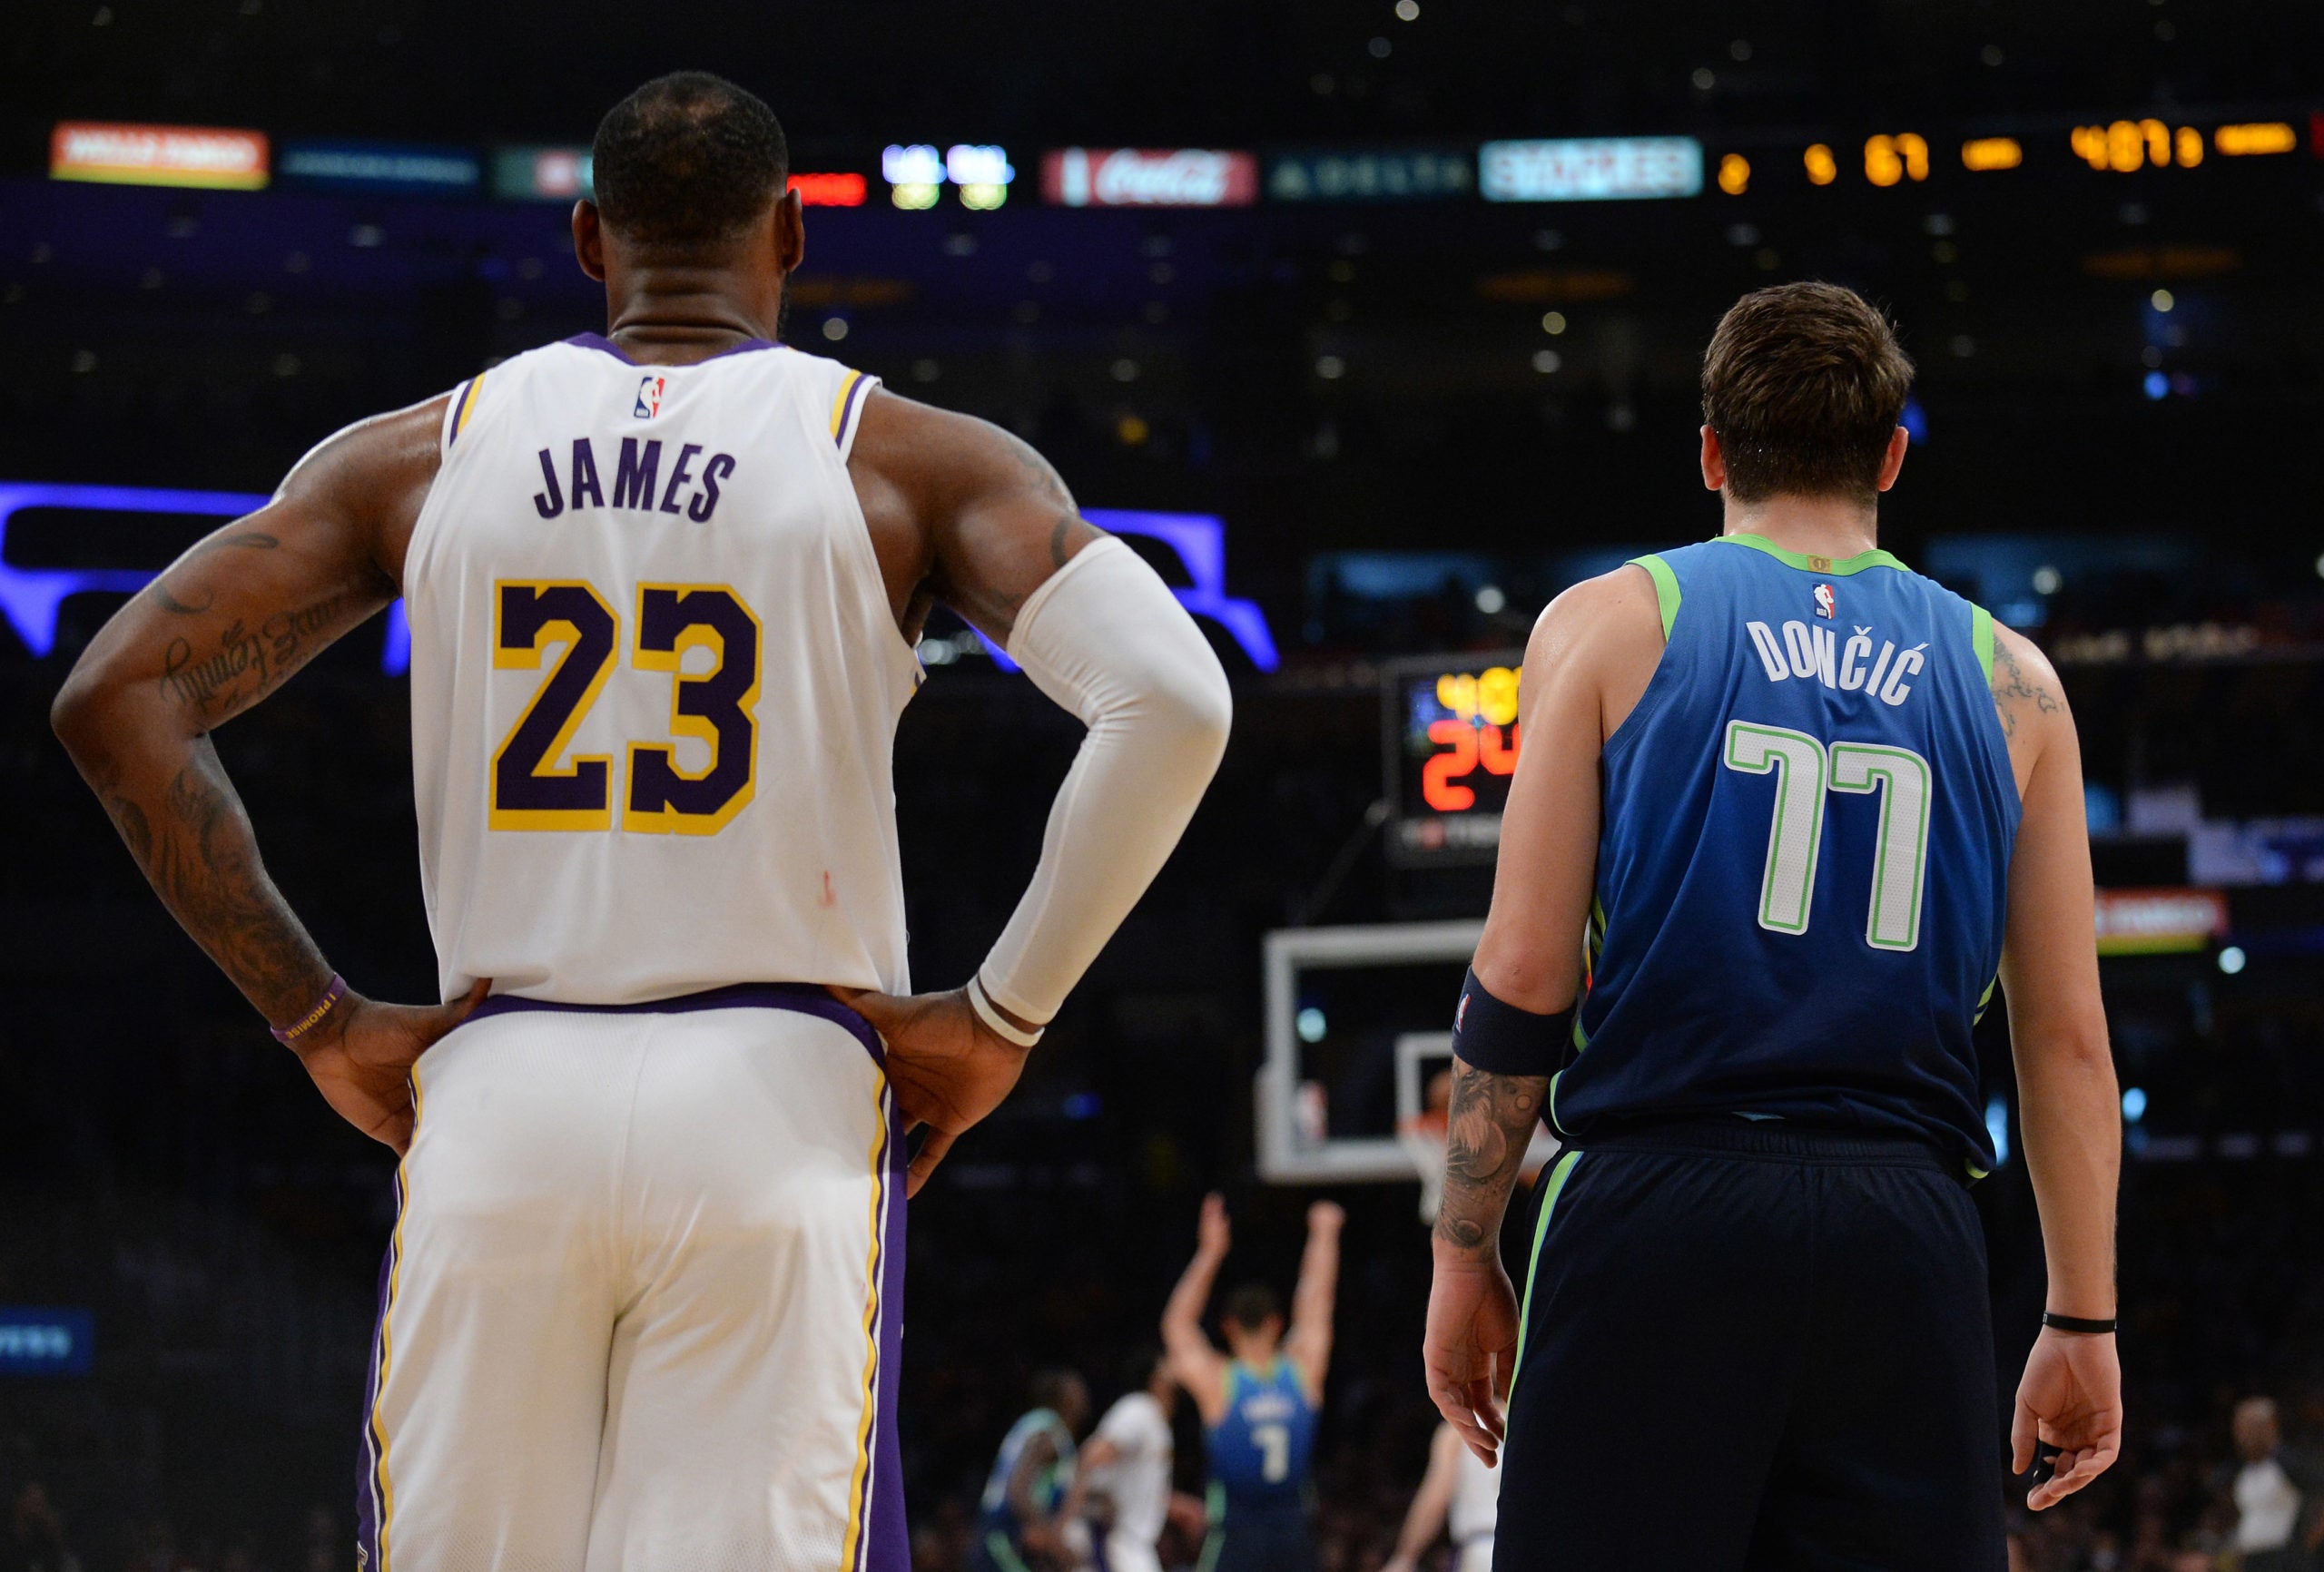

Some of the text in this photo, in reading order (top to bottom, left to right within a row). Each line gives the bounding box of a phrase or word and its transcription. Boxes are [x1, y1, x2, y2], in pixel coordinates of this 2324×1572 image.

[534, 437, 735, 523] JAMES
[1746, 621, 1930, 705] DONČIĆ
[488, 579, 763, 836] 23
[1724, 720, 1932, 951] 77
[285, 999, 331, 1039] PROMISE
